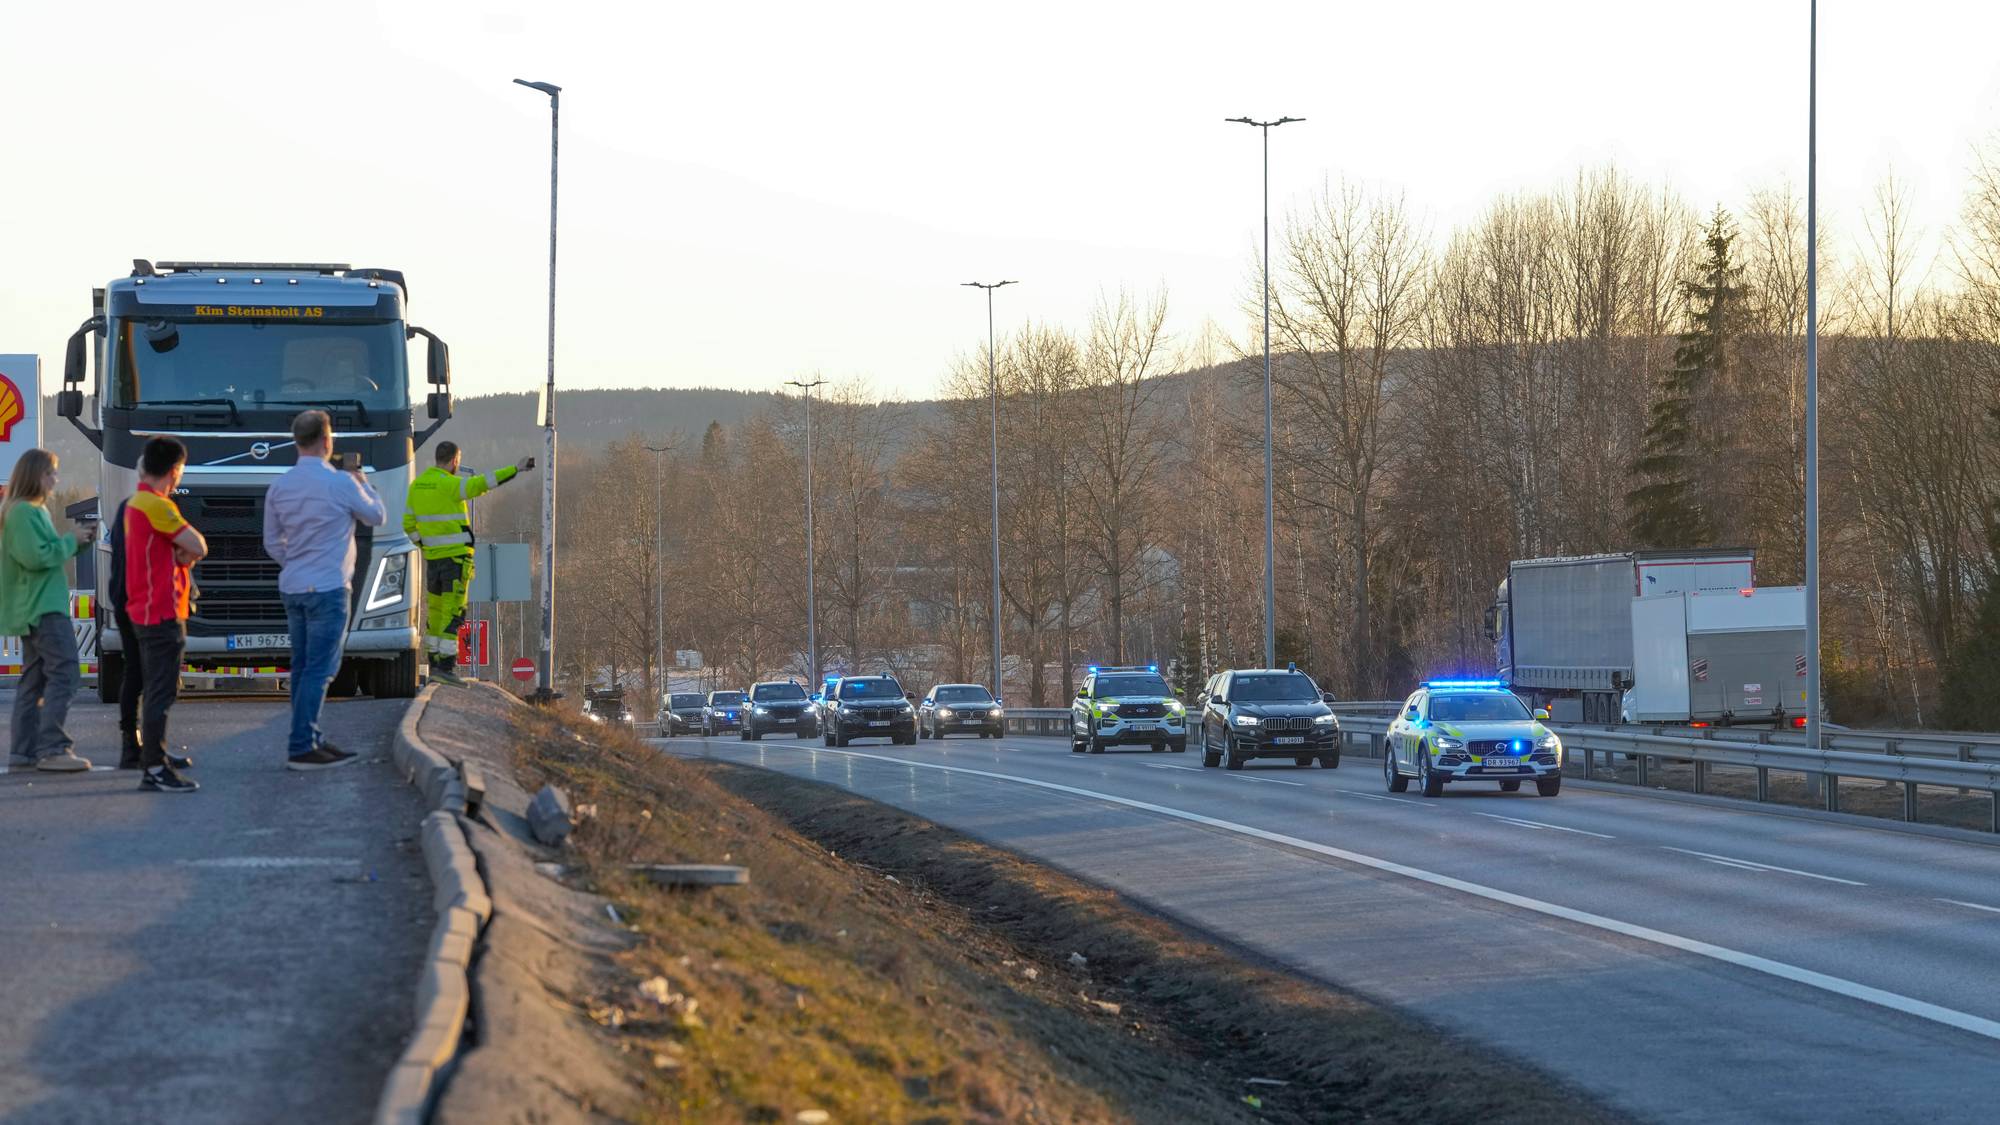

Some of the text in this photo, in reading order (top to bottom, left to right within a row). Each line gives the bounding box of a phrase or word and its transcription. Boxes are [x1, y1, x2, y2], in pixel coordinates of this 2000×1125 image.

[195, 306, 323, 317] Kim Steinsholt AS
[237, 637, 253, 647] KH
